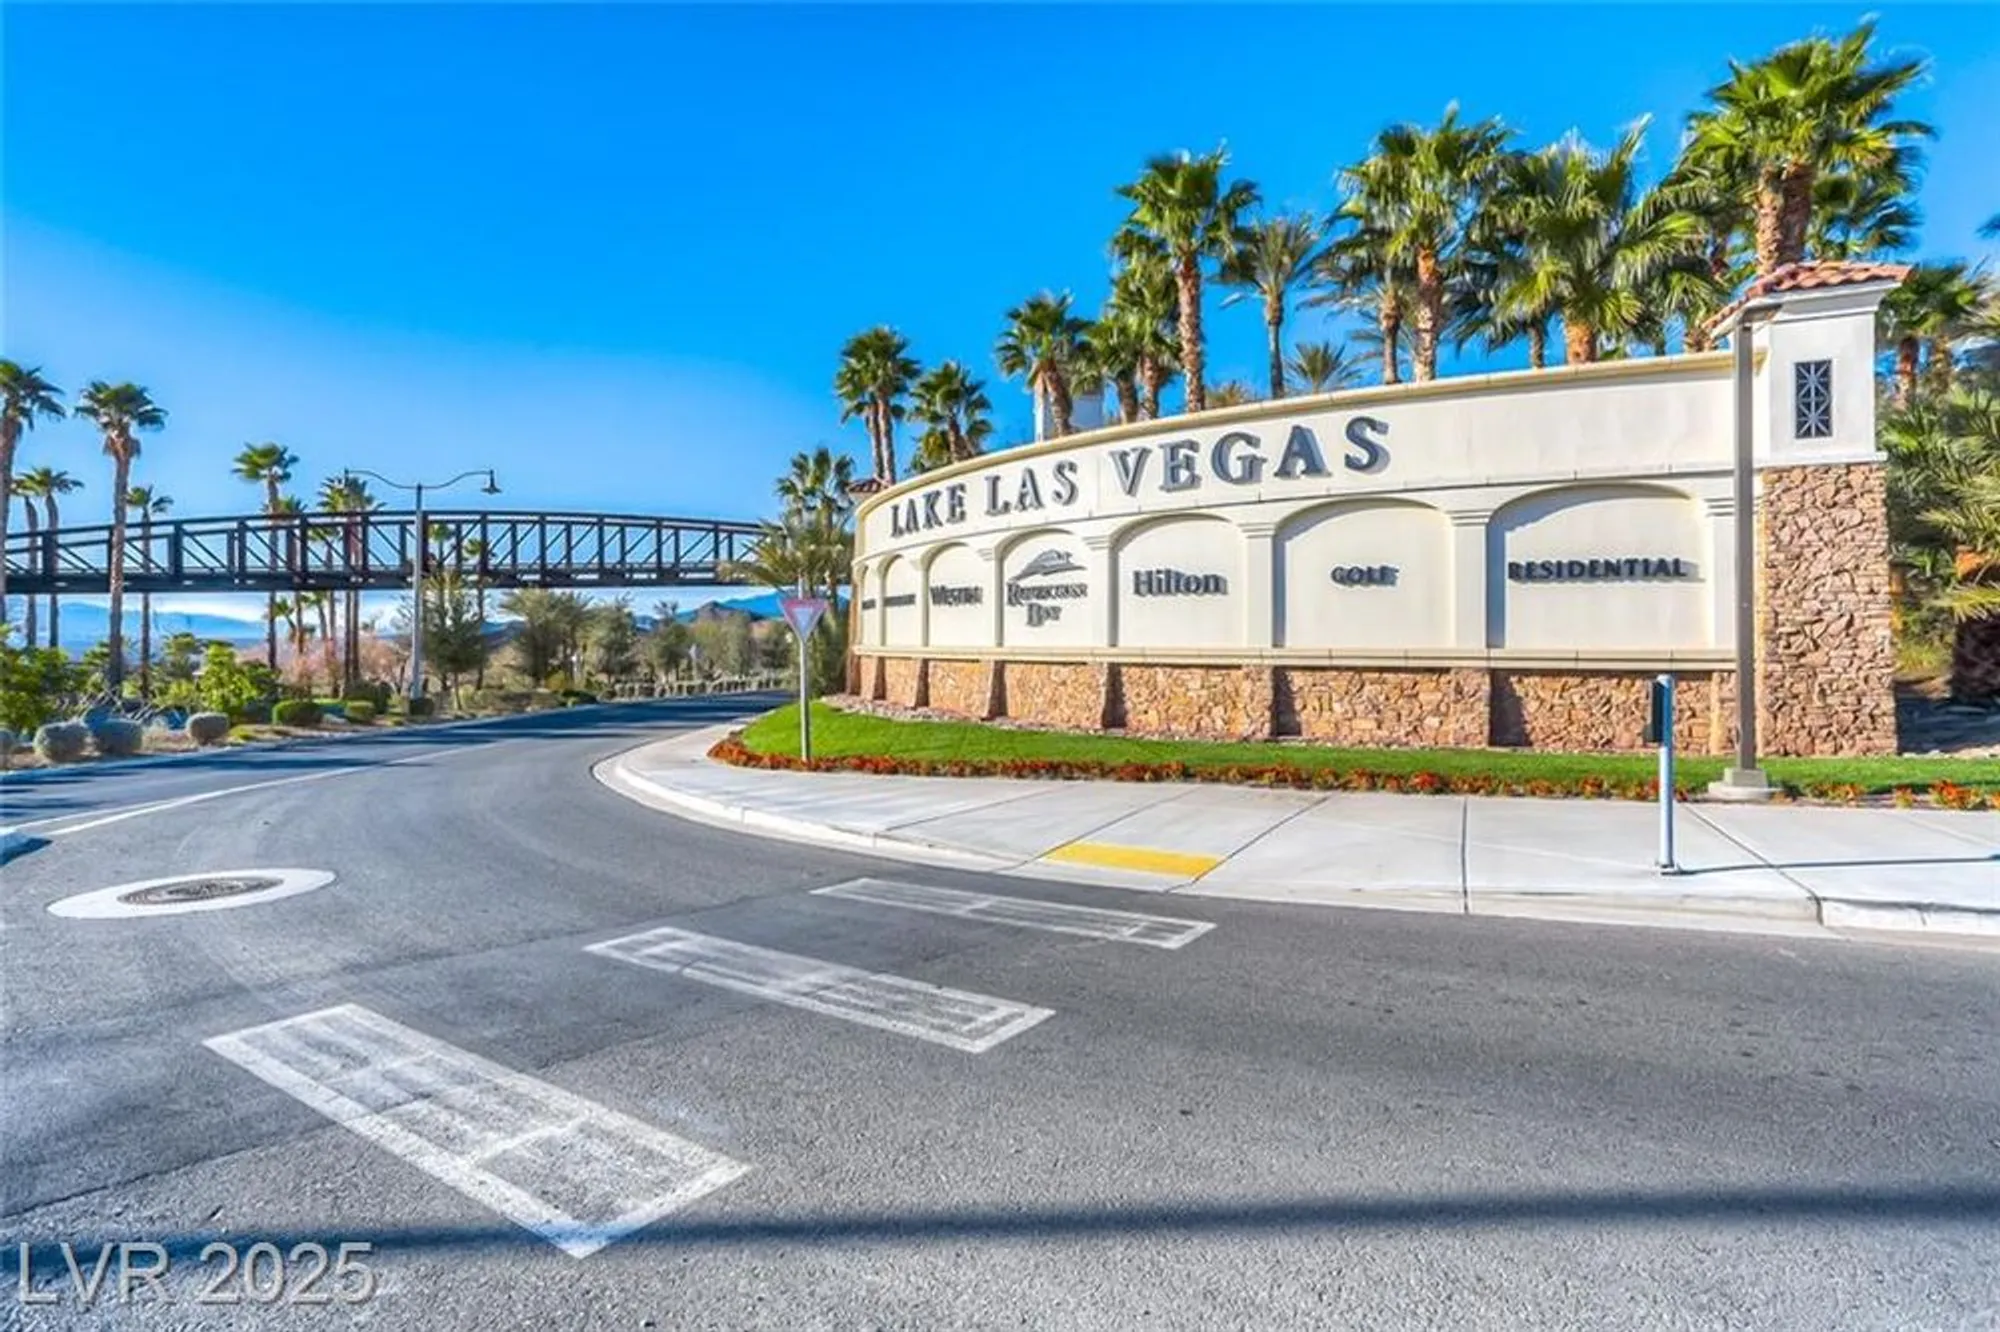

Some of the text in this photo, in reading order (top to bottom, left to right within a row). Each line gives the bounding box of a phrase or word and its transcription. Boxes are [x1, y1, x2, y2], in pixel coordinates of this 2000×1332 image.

[891, 416, 1391, 538] LAKE LAS VEGAS
[1132, 568, 1226, 596] Hilton
[1330, 565, 1397, 587] GOLF
[1508, 557, 1690, 581] RESIDENTIAL
